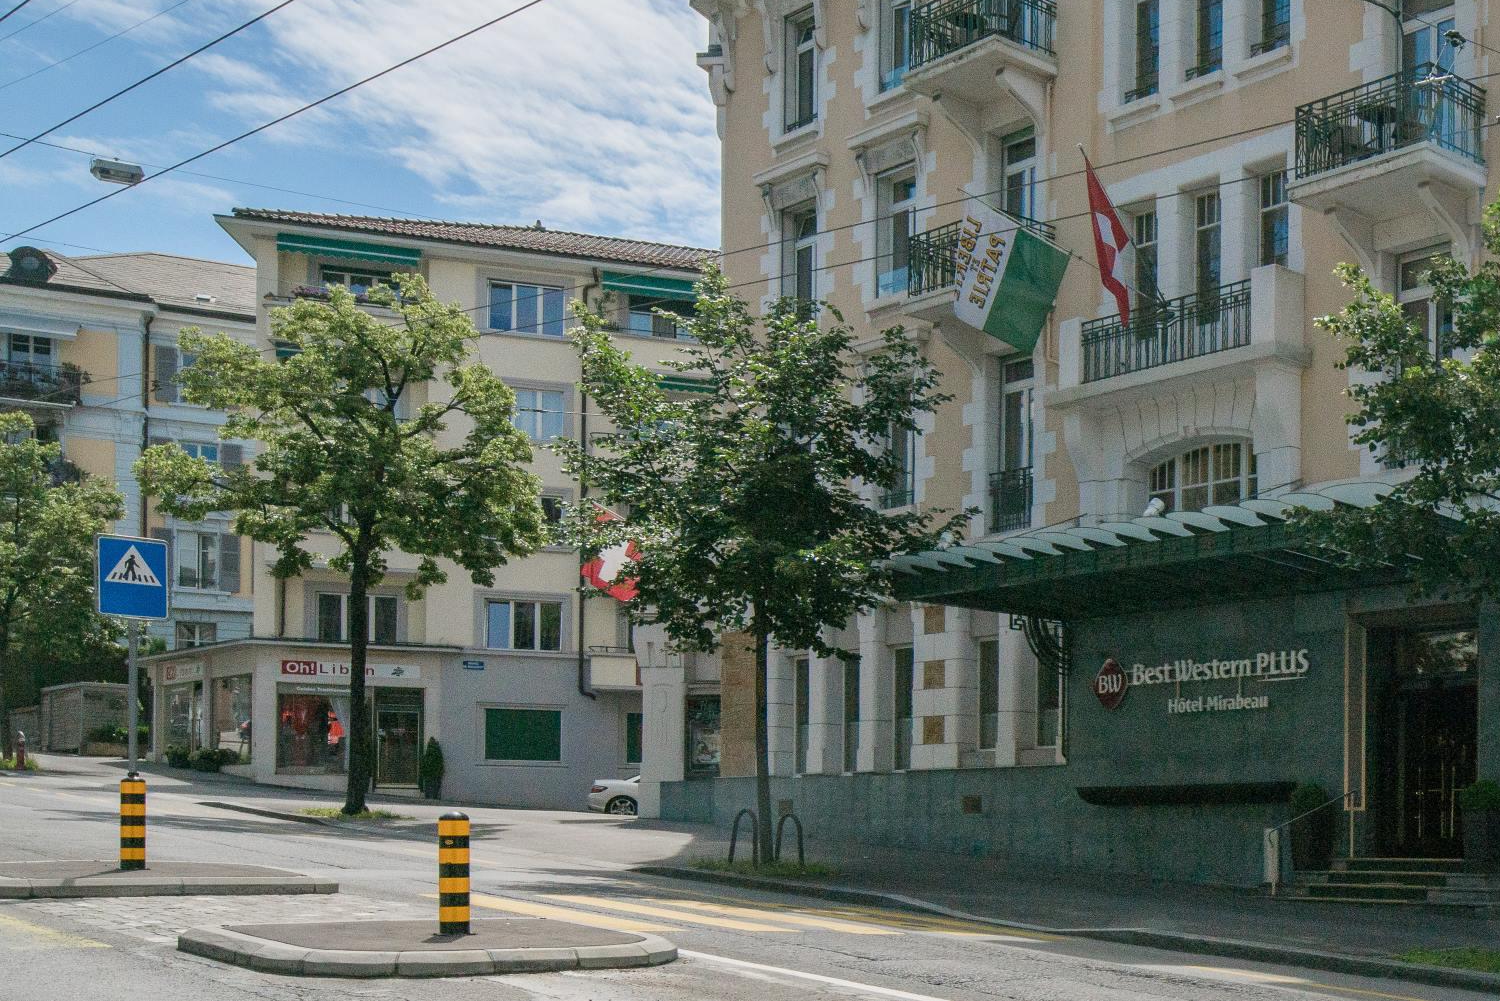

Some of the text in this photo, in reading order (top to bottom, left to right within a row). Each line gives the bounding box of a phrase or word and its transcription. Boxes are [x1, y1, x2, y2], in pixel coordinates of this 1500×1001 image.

[286, 662, 375, 676] Oh! Libn
[1132, 649, 1310, 686] Best Western PLUS
[1098, 673, 1122, 694] BW
[1168, 694, 1269, 714] Hôtel Mirabeau
